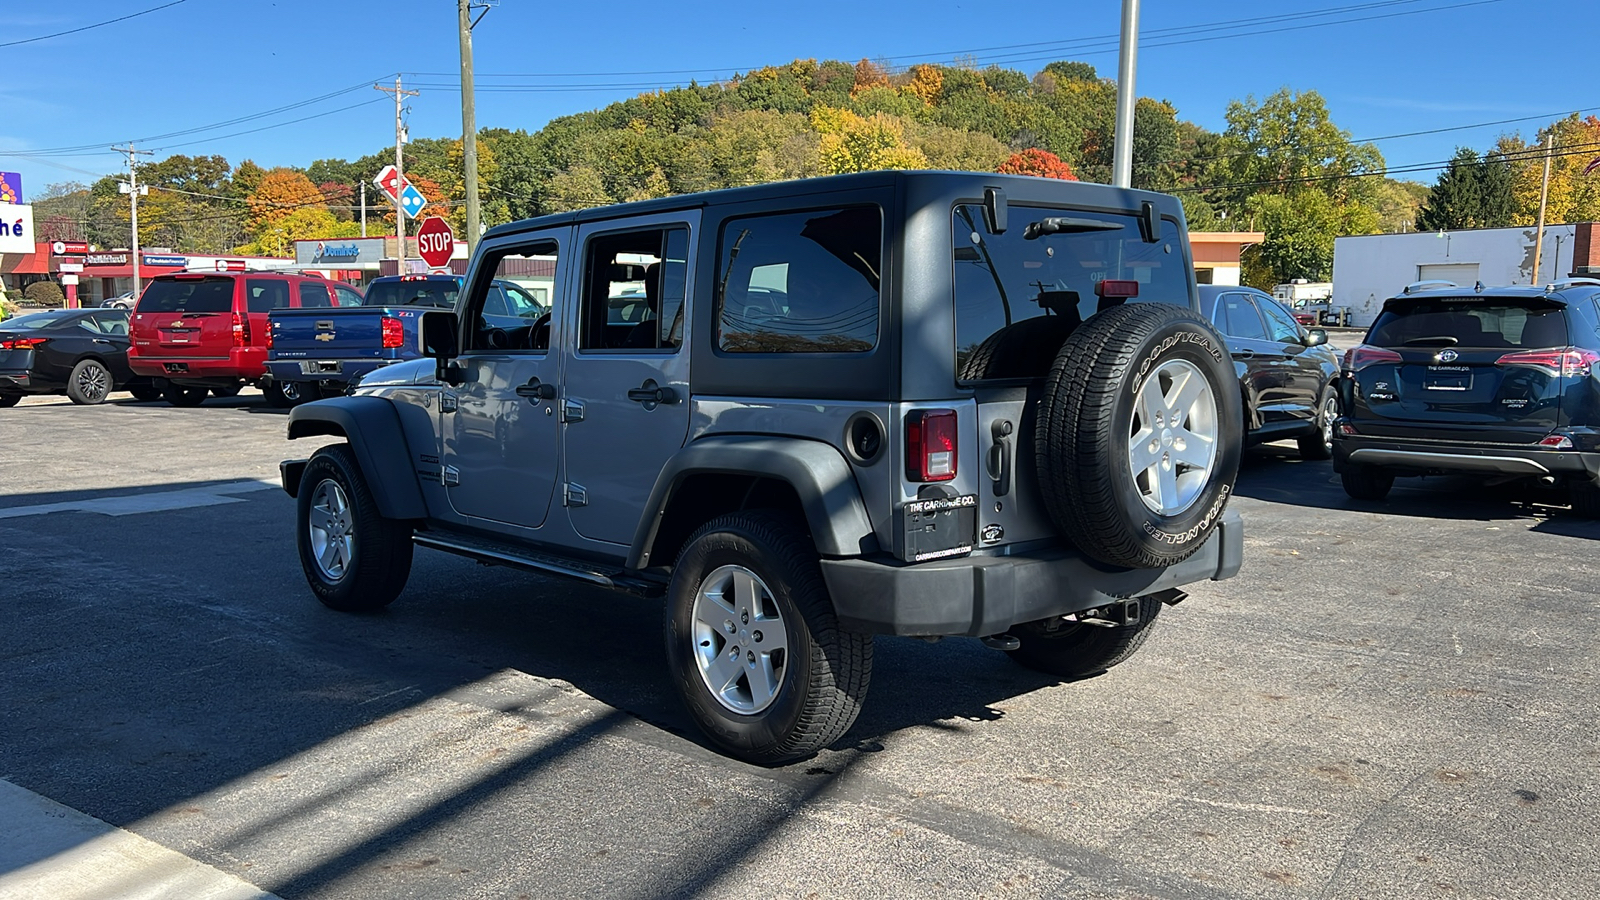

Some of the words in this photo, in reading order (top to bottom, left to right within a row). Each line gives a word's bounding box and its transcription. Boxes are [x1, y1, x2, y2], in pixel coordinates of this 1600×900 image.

[323, 243, 359, 257] Domino's
[420, 232, 451, 254] STOP
[1131, 331, 1223, 394] GOODYEAR
[909, 502, 924, 513] THE
[923, 497, 961, 509] CARRIAGE
[961, 495, 975, 506] CO.
[1142, 484, 1230, 545] WRANGLER
